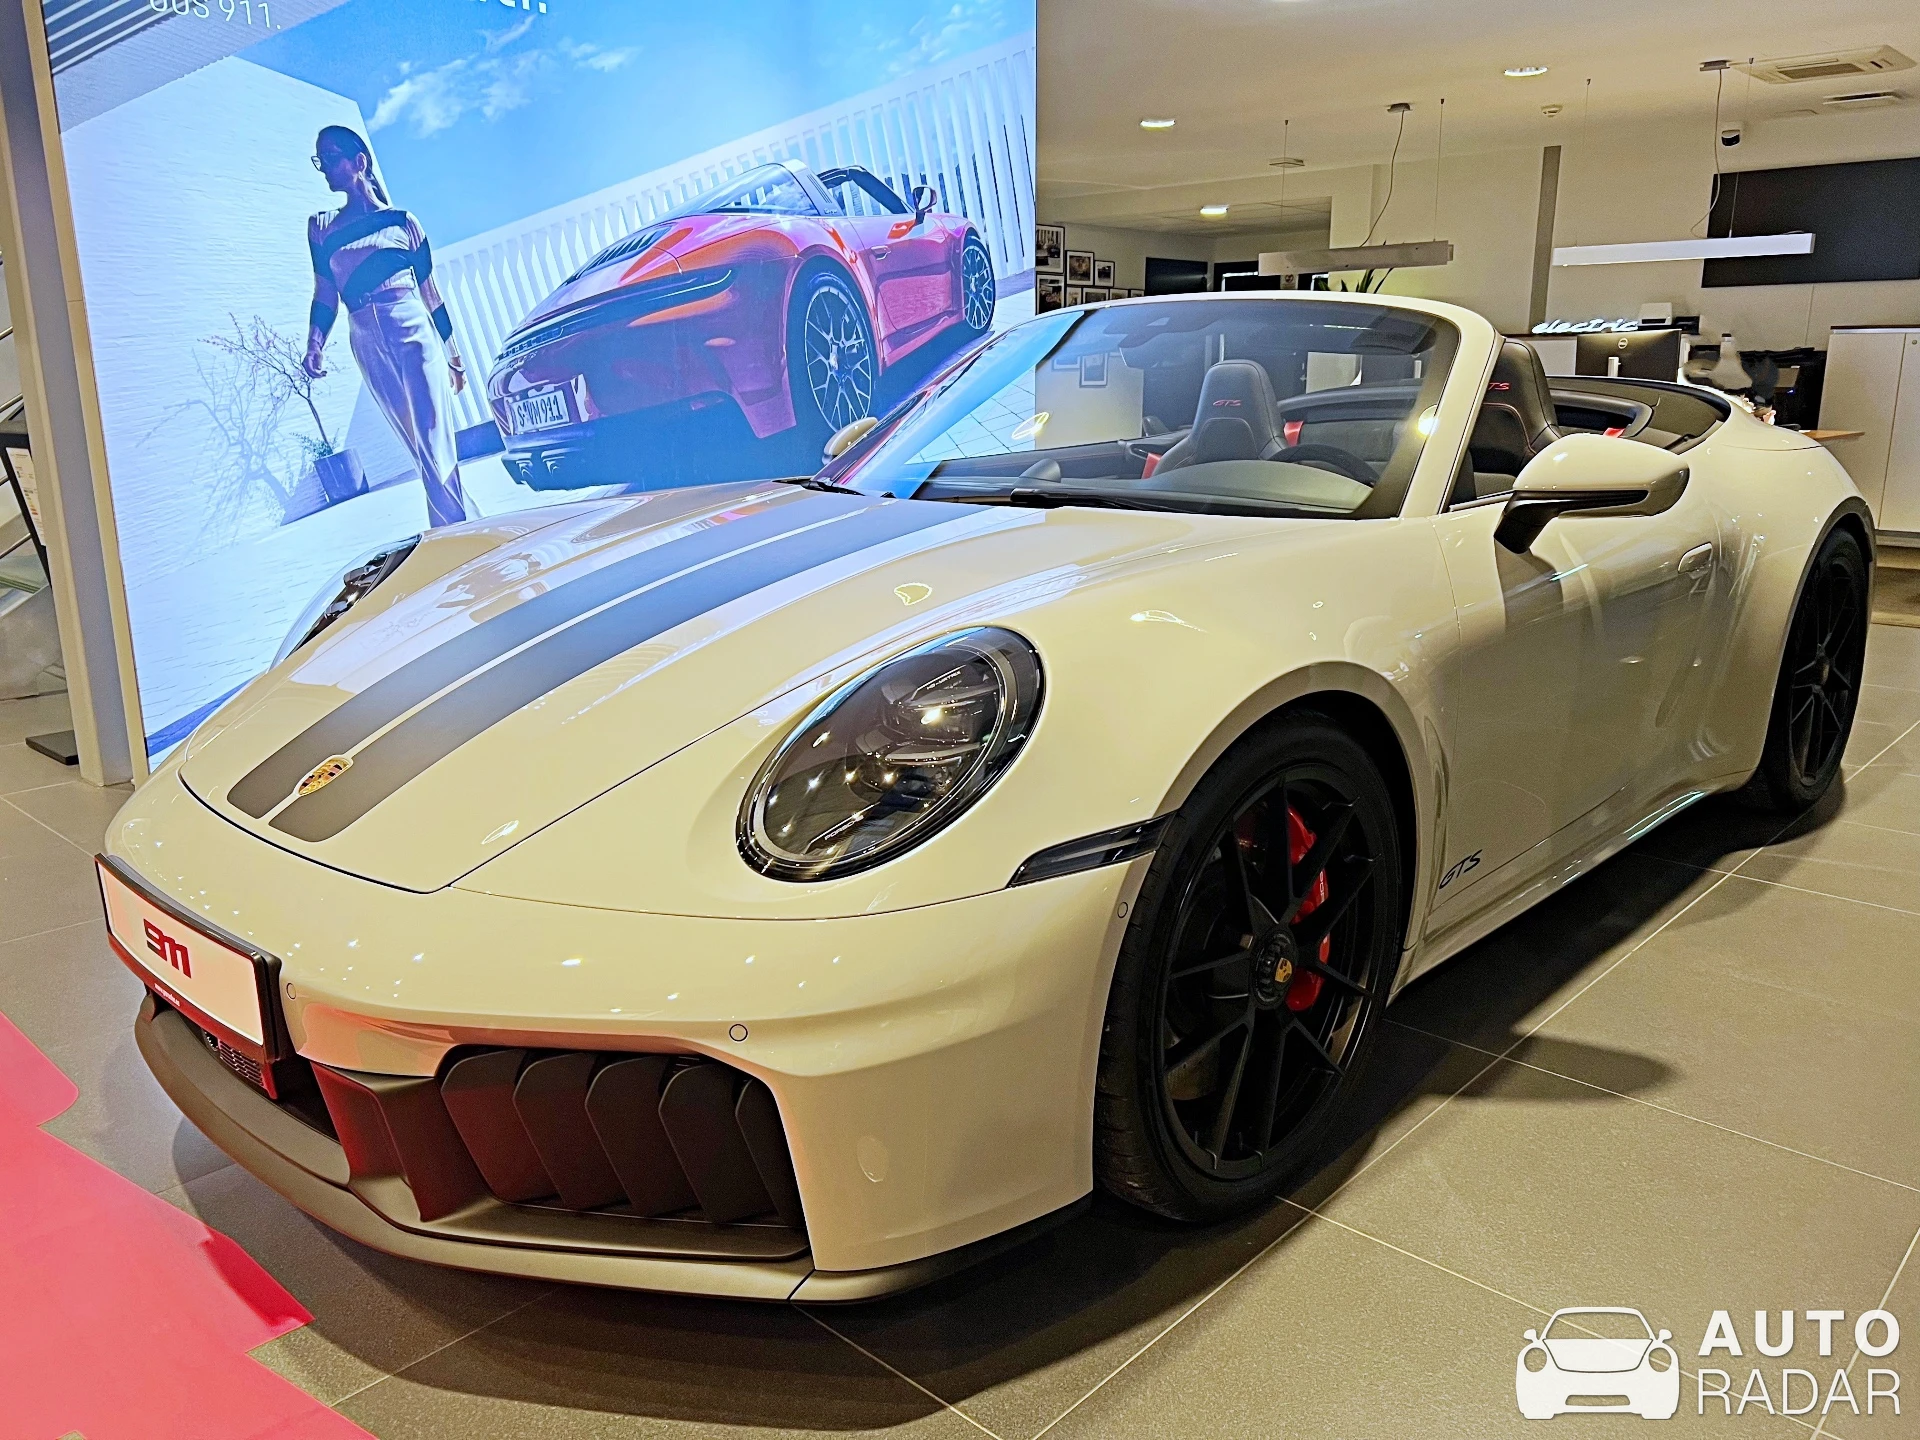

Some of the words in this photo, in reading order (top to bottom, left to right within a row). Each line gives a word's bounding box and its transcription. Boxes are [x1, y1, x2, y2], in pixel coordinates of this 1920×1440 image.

[218, 0, 281, 30] 911.
[1531, 317, 1639, 334] electric
[1488, 382, 1510, 390] TS
[1212, 399, 1241, 407] GTS
[1438, 849, 1483, 889] GTS
